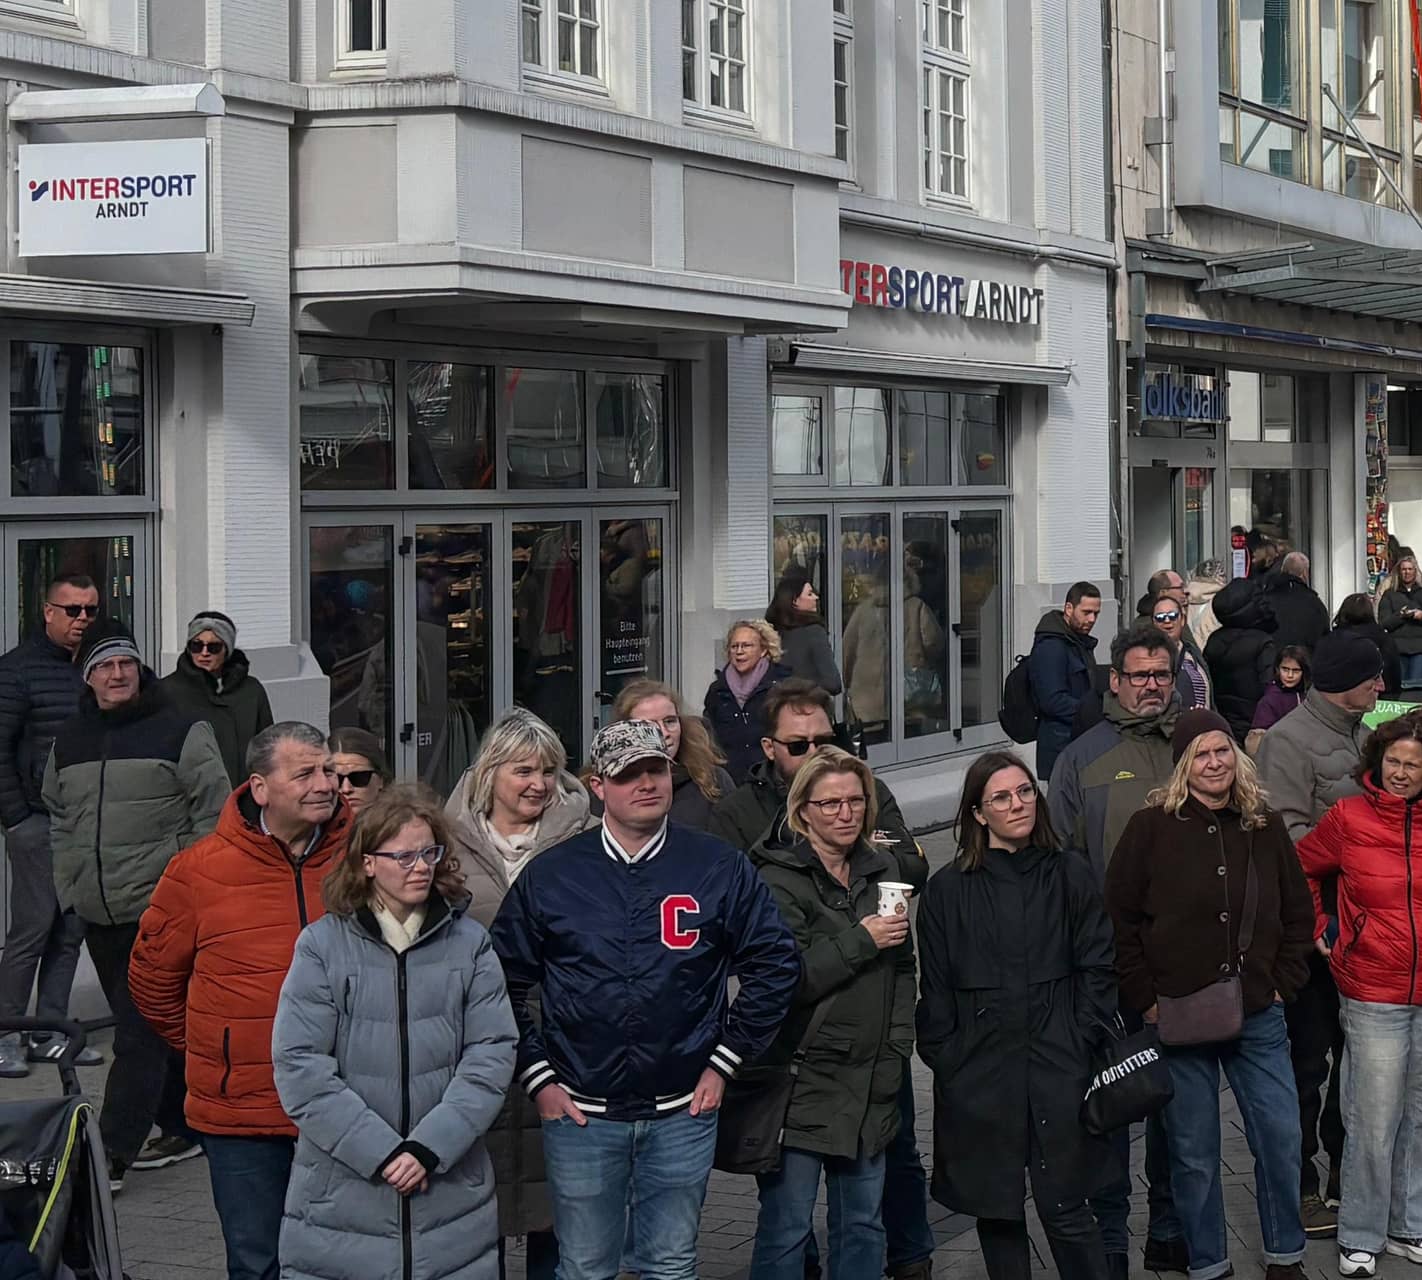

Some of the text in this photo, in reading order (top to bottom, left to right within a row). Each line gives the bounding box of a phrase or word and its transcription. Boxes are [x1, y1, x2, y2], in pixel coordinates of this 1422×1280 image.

[52, 174, 197, 201] INTERSPORT
[95, 201, 149, 219] ARNDT
[974, 279, 1044, 325] ARNDT
[660, 894, 701, 950] C
